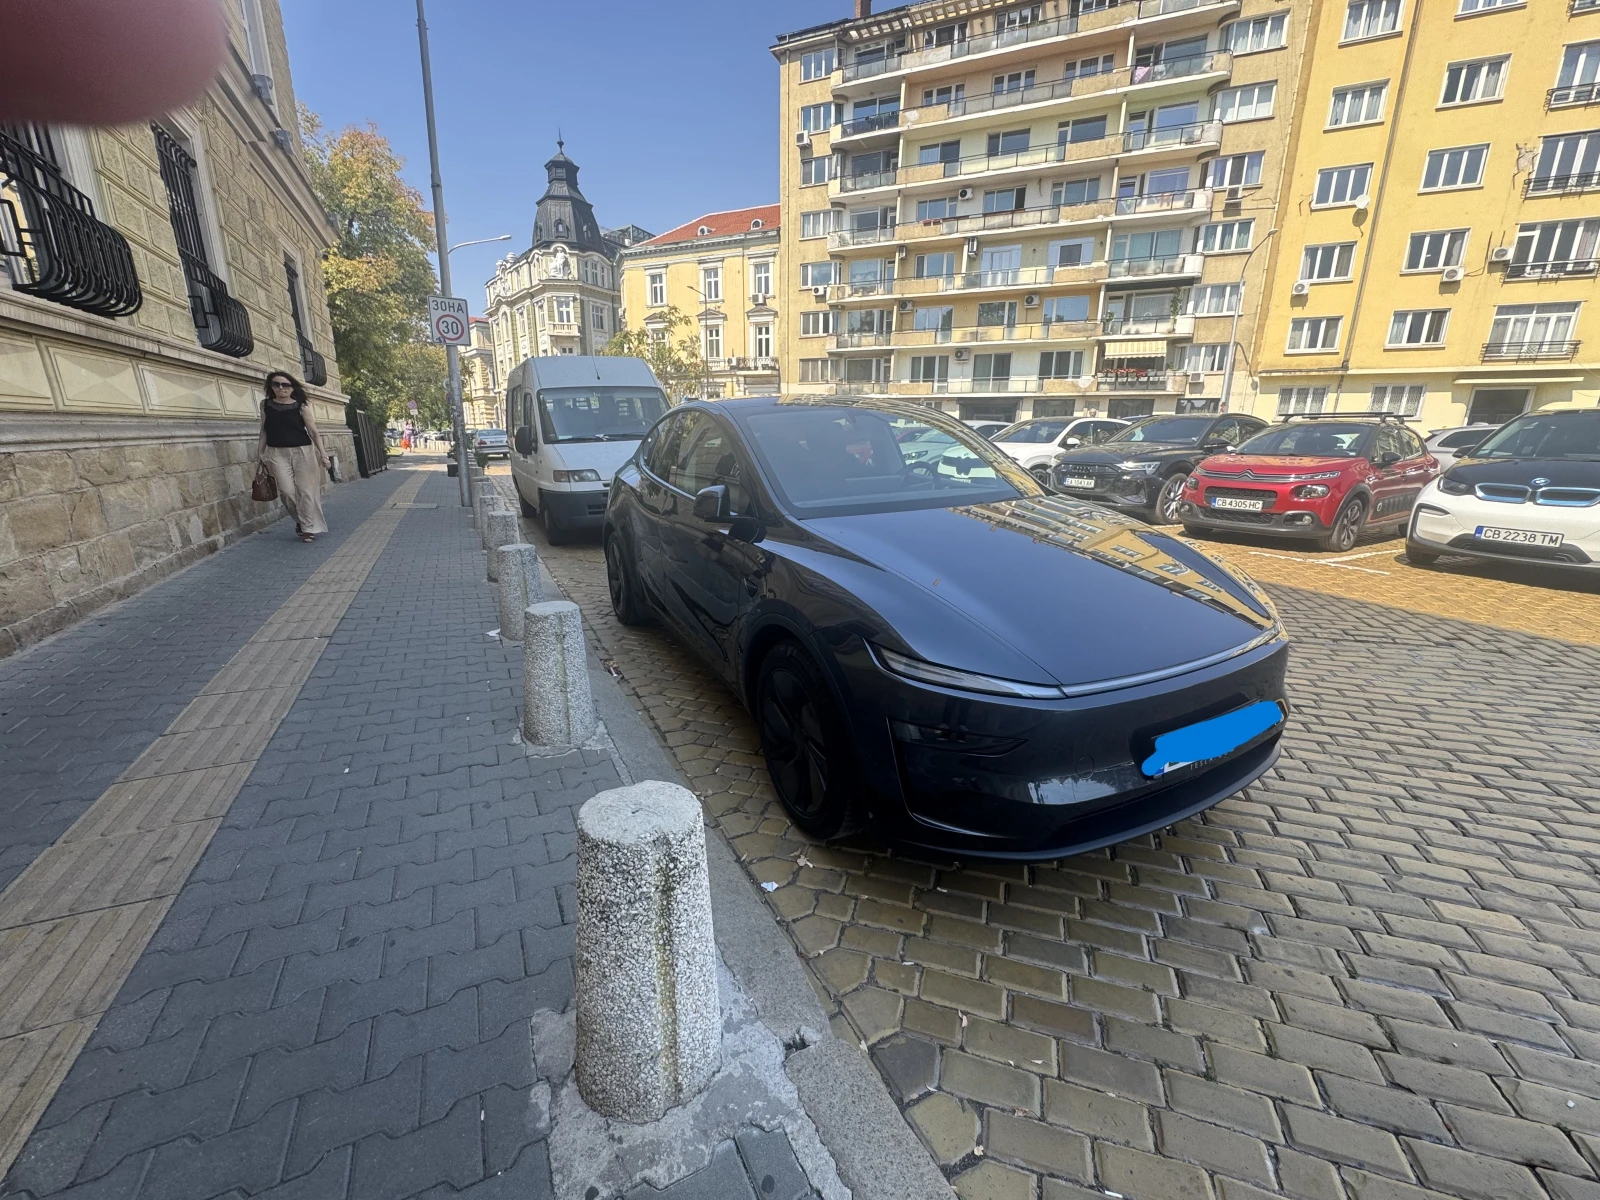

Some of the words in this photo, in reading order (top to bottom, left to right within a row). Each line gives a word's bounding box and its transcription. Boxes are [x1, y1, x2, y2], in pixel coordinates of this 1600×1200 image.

[432, 299, 464, 314] ЗОНА
[441, 320, 459, 335] 30
[1216, 498, 1227, 507] CB
[1228, 499, 1248, 509] 4305
[1248, 501, 1261, 510] HC
[1483, 529, 1501, 540] CB
[1502, 531, 1537, 544] 2238
[1540, 534, 1560, 546] TM
